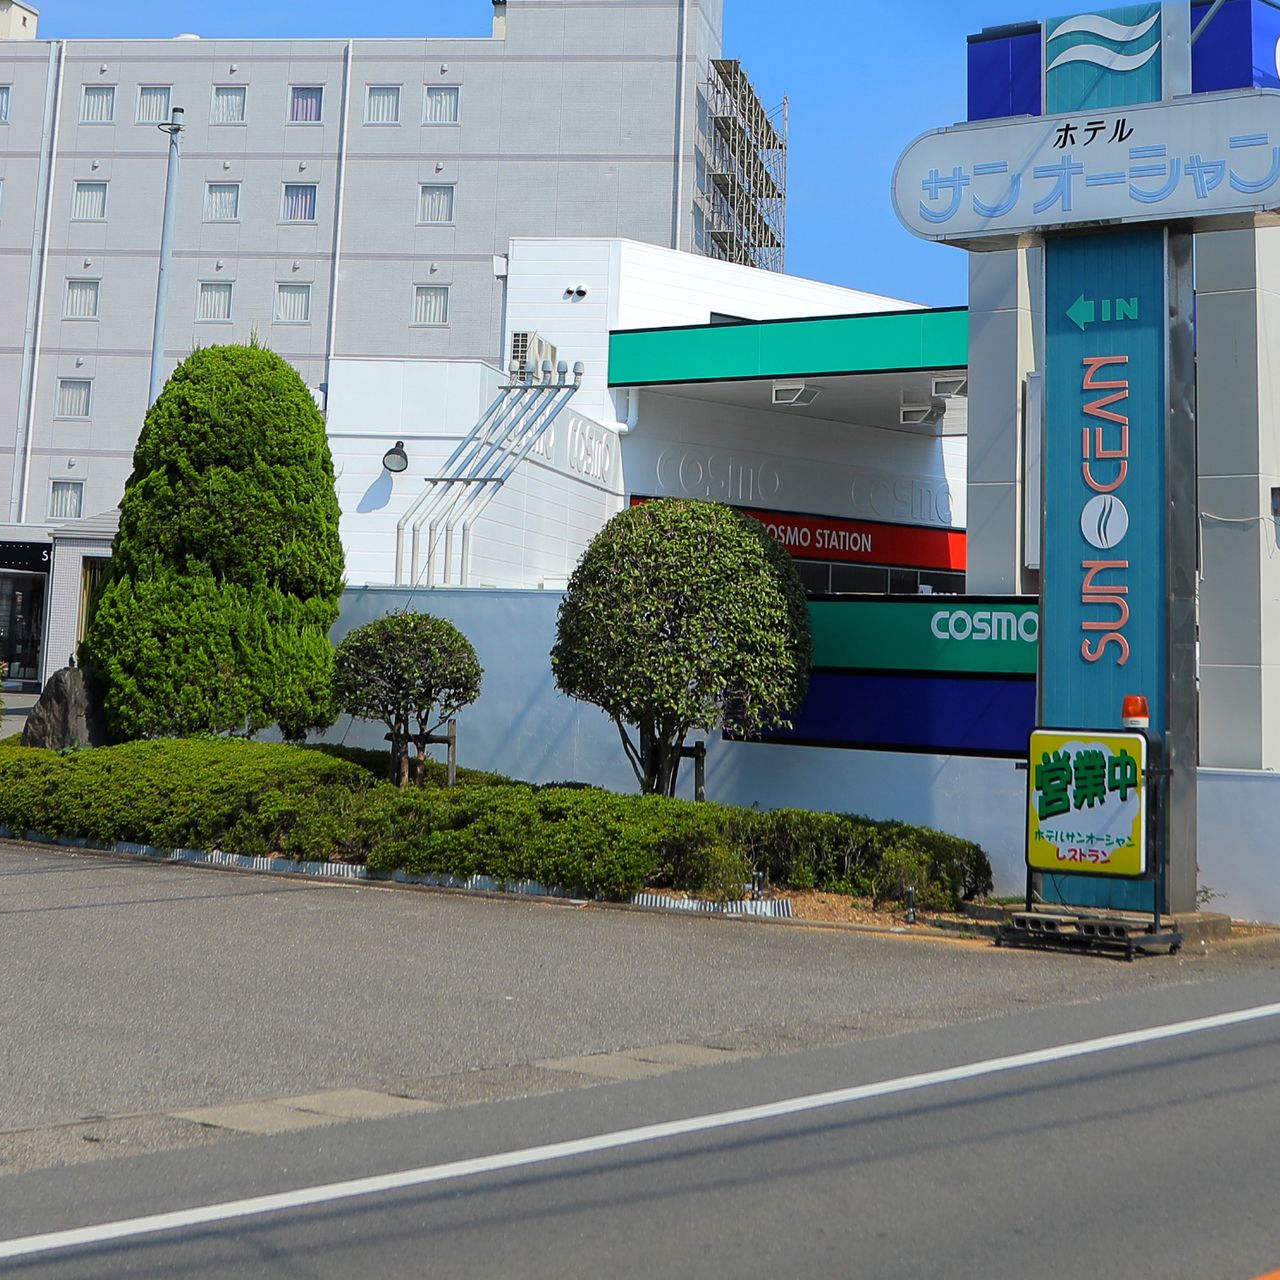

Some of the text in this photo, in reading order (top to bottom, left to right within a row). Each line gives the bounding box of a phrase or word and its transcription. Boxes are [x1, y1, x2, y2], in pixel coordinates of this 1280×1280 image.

[1052, 118, 1134, 149] ホテル
[1101, 297, 1138, 322] IN
[762, 522, 872, 553] OSMO STATION
[930, 610, 1039, 642] COSMO
[1081, 560, 1130, 667] SUN
[1035, 748, 1138, 821] 営業中
[1055, 847, 1111, 864] レストラン
